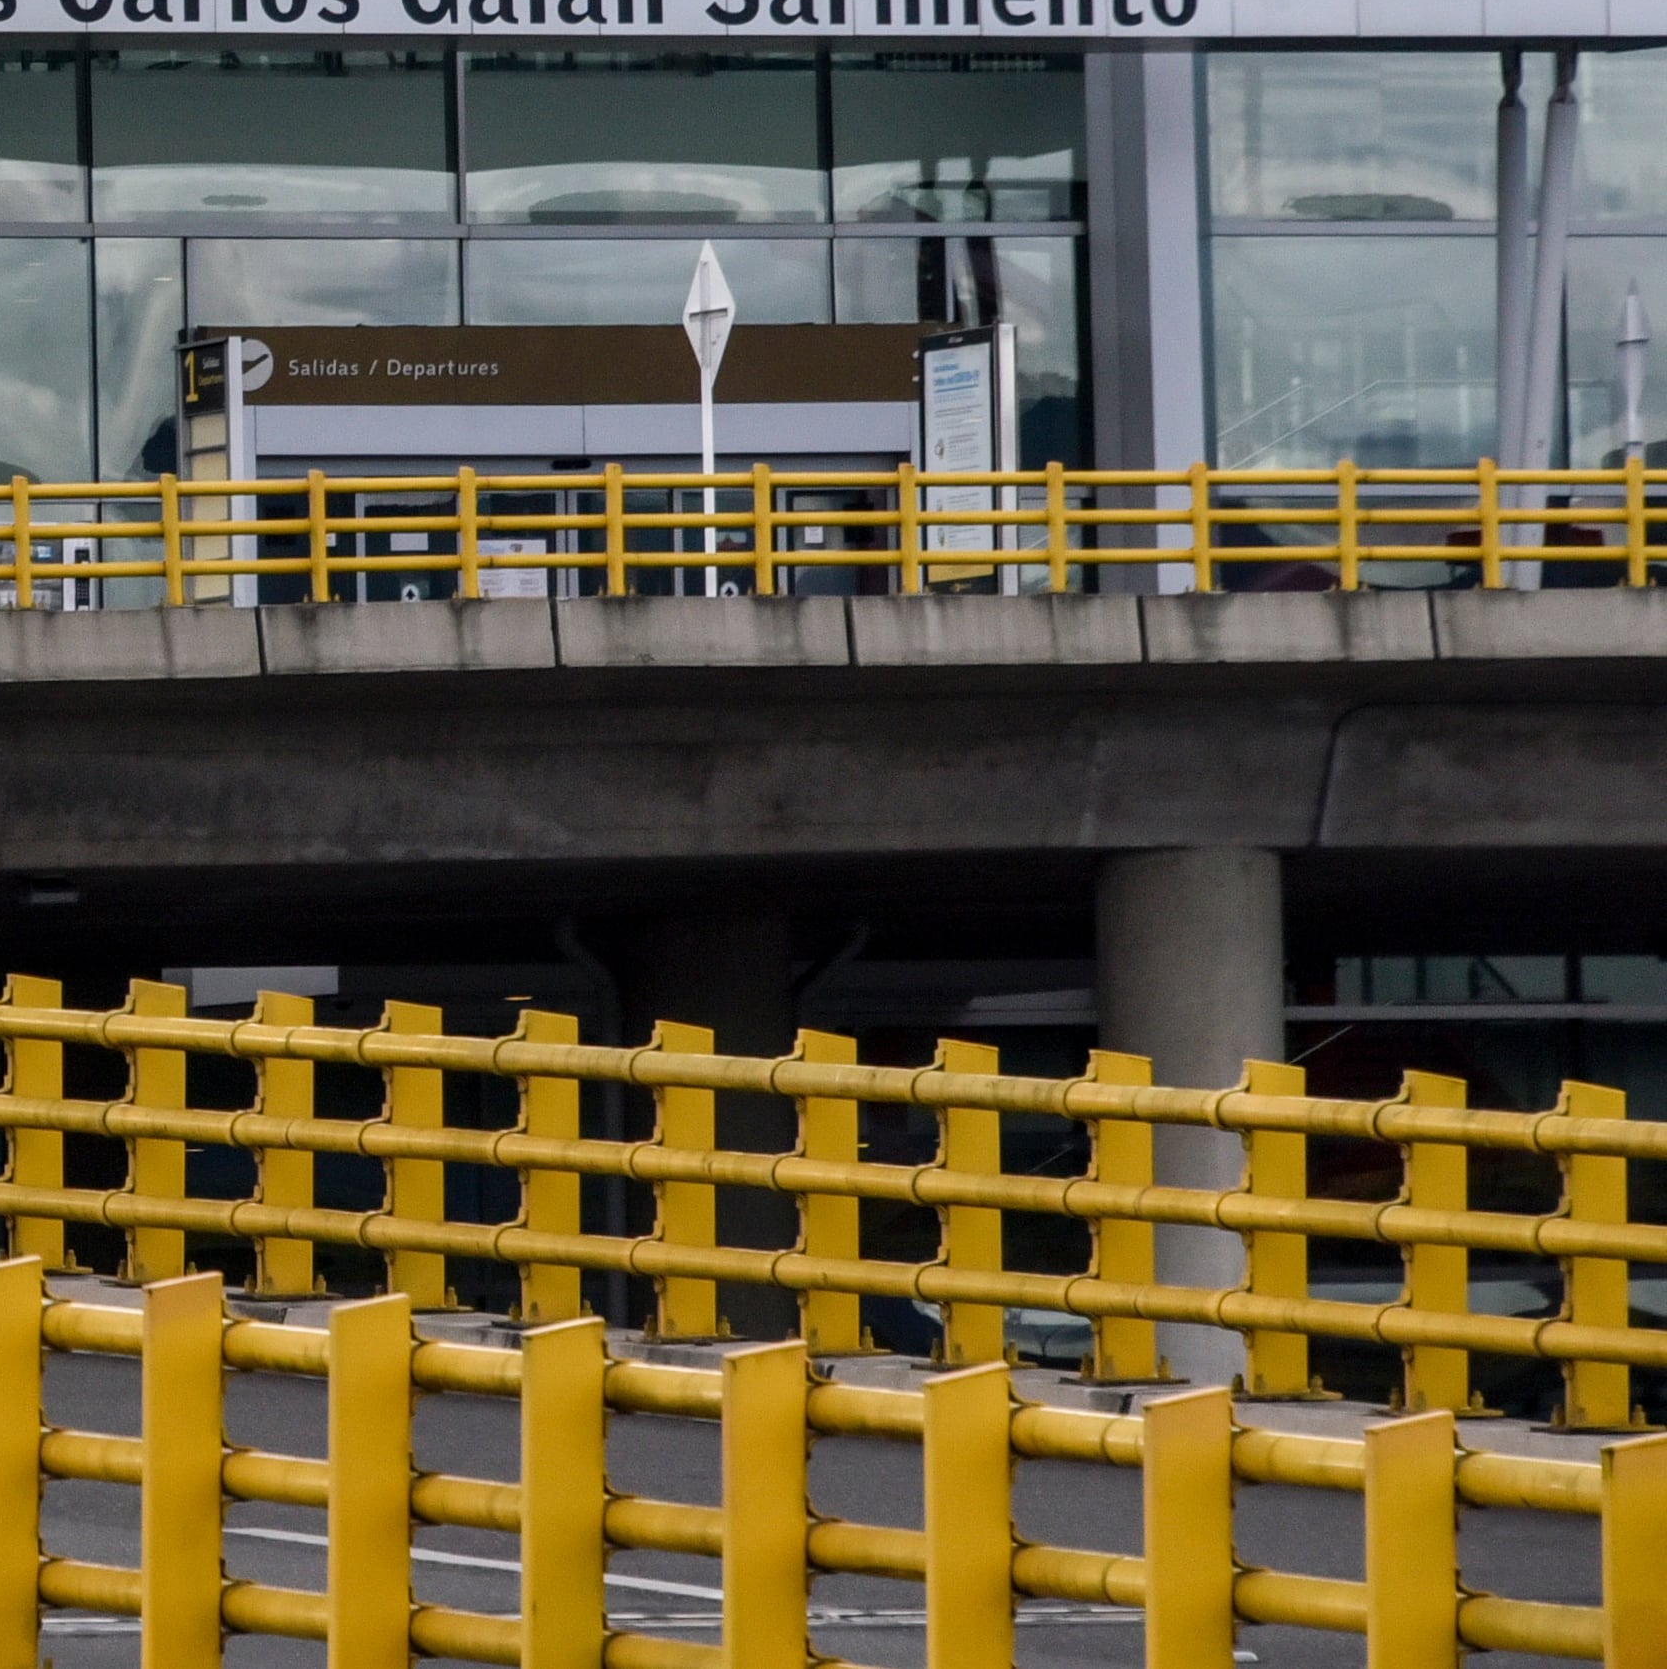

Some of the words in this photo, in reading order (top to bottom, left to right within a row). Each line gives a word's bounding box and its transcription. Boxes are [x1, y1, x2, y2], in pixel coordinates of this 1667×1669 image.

[184, 350, 199, 403] 1
[288, 359, 359, 376] Salidas
[368, 359, 378, 376] /
[386, 358, 499, 380] Departures
